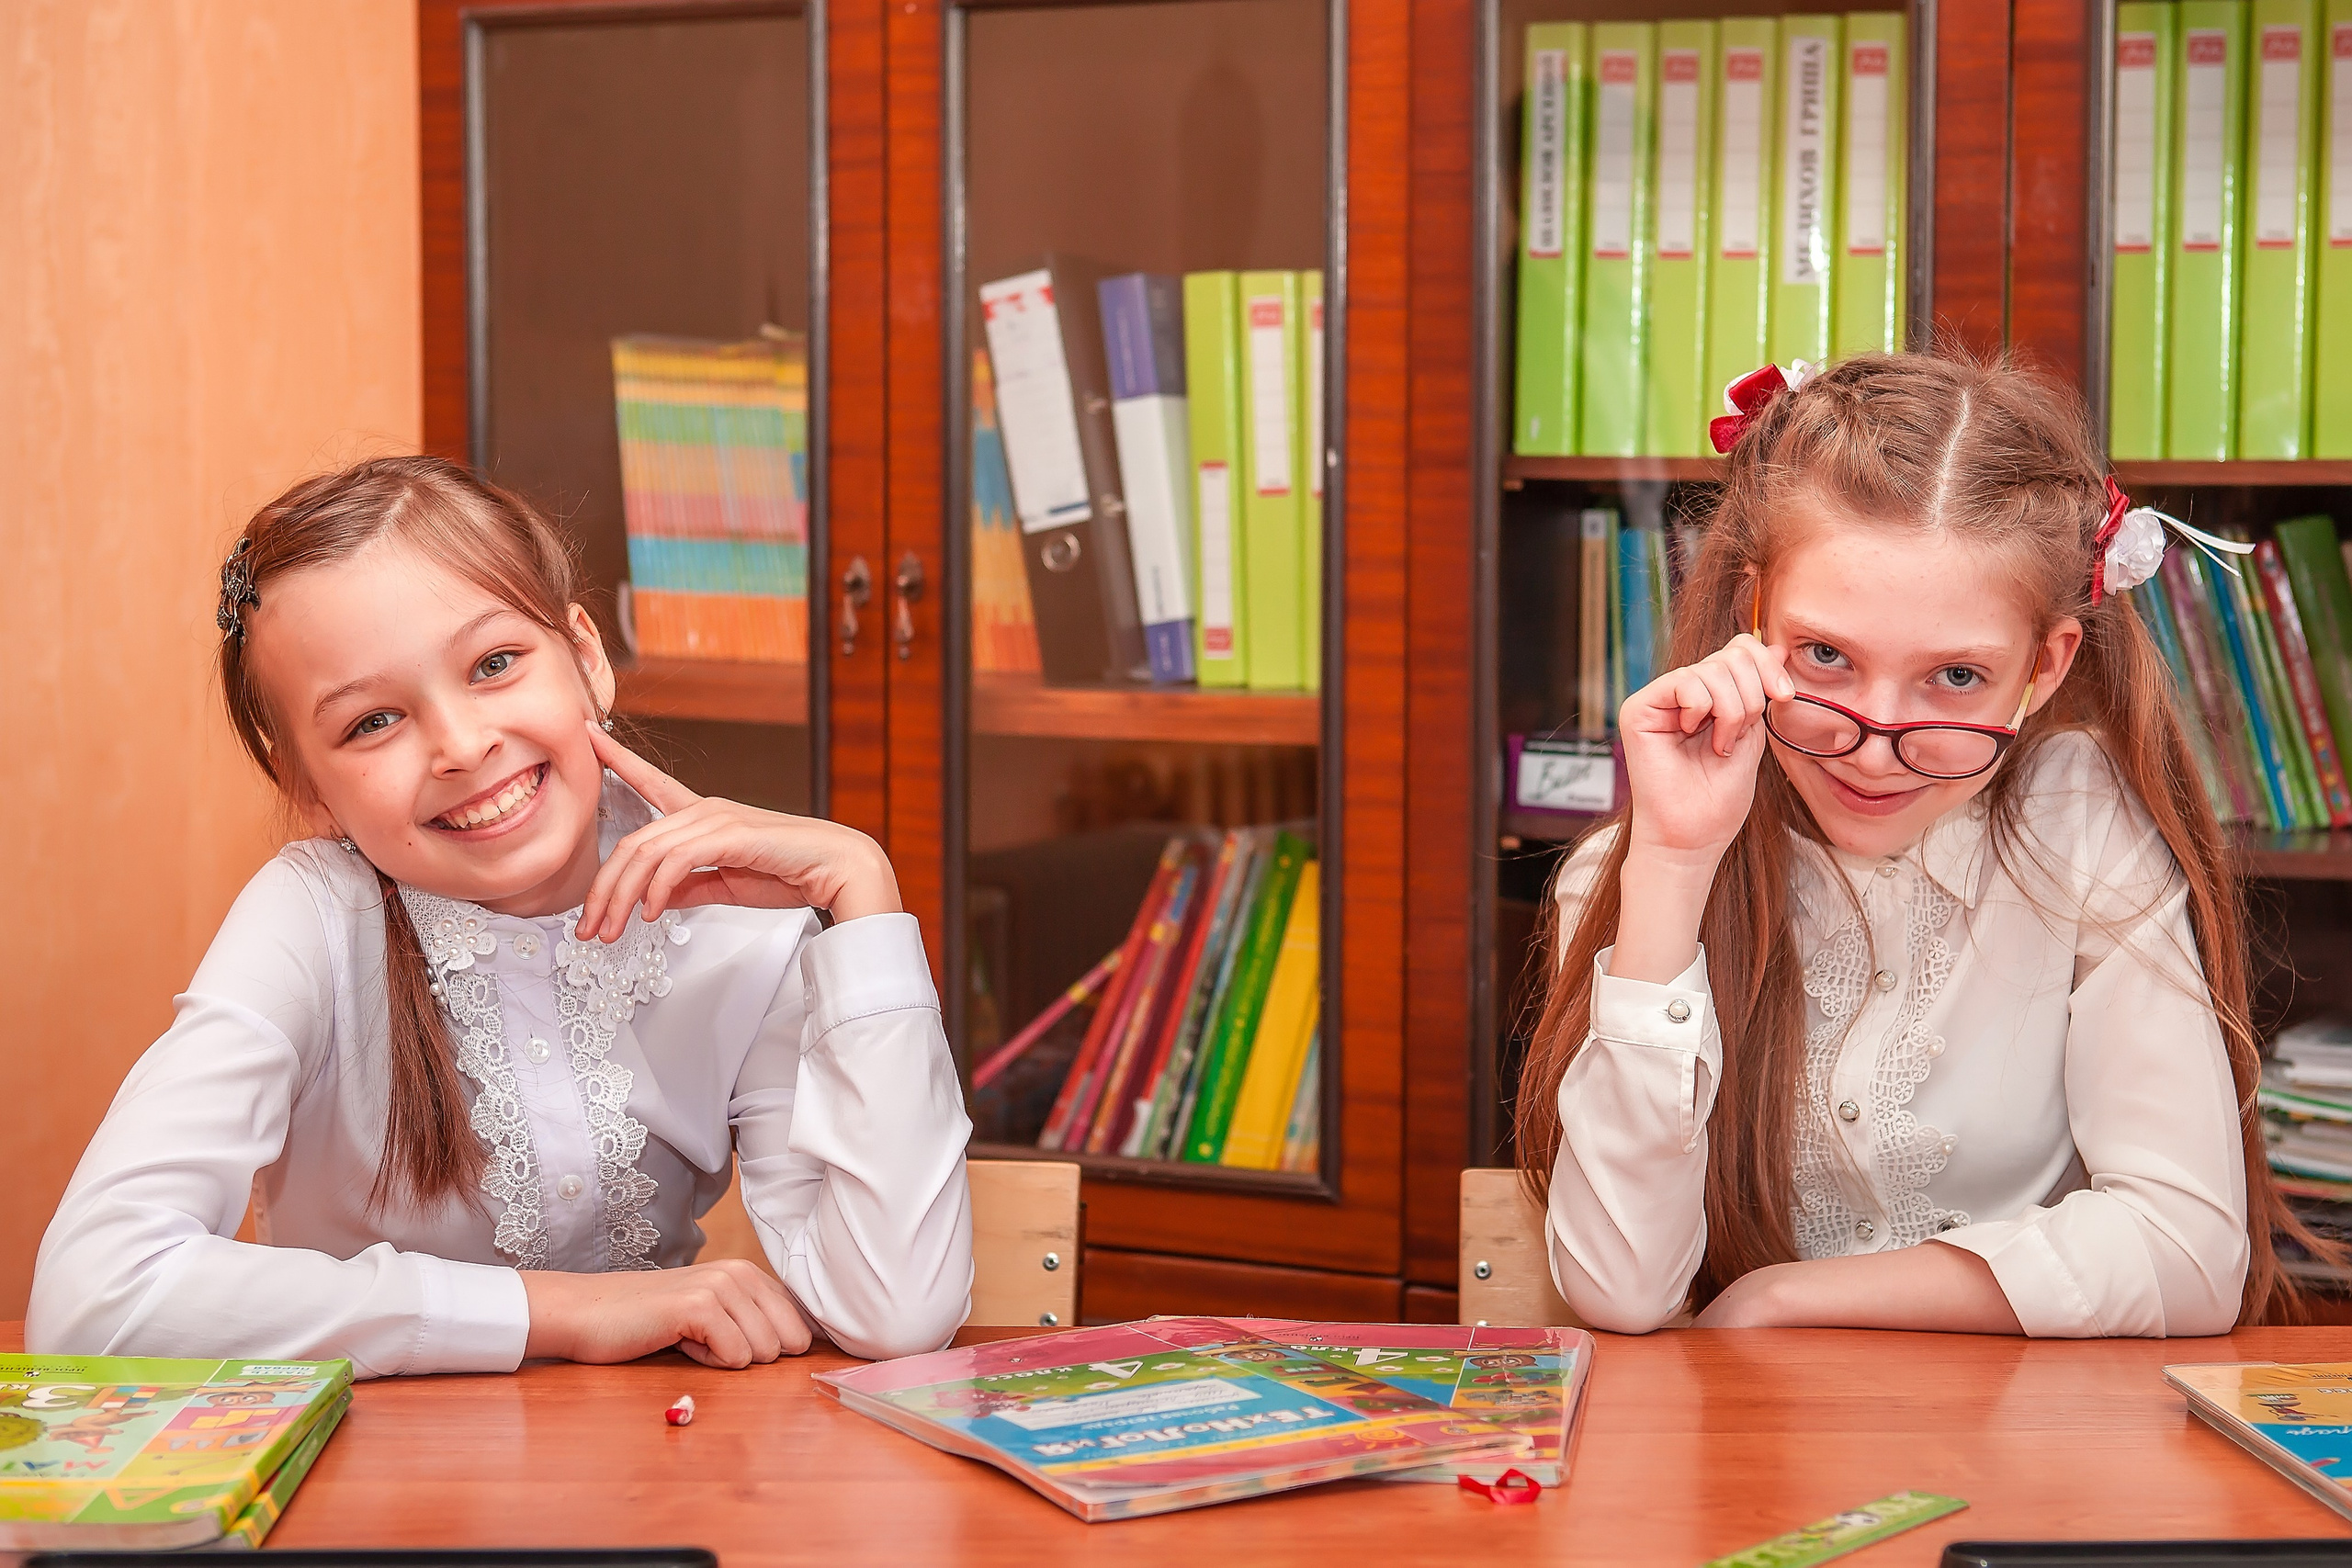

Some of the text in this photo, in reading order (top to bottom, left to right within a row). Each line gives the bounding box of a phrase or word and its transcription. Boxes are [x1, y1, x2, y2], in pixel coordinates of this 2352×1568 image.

[1290, 1344, 1409, 1367] 4 кла
[1087, 1359, 1145, 1380] 4
[21, 1383, 98, 1409] 3
[2286, 1426, 2352, 1436] радь
